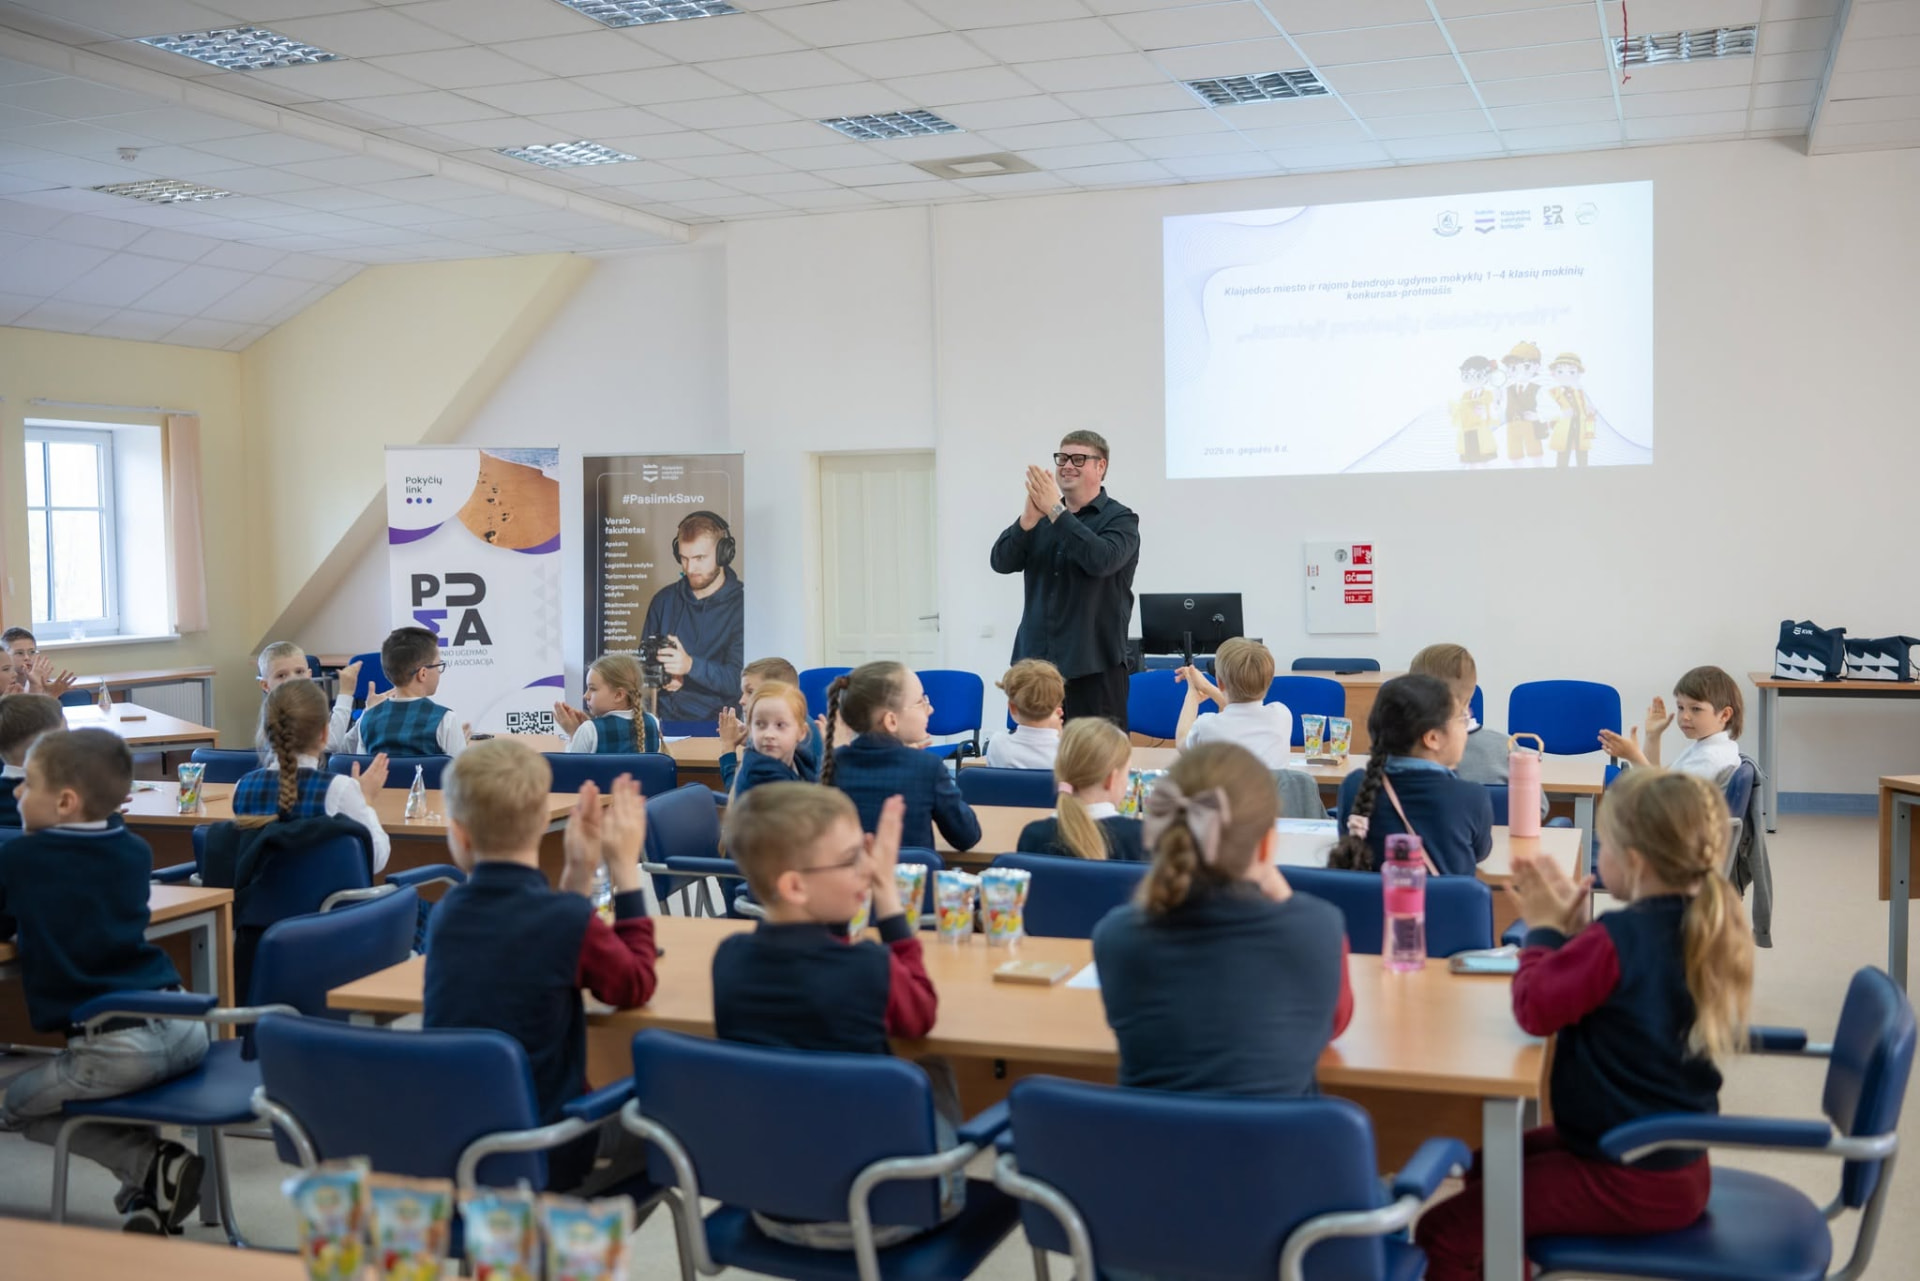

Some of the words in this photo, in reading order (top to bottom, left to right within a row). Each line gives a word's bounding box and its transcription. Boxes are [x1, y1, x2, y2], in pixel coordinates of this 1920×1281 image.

[1273, 282, 1306, 293] miesto
[1308, 281, 1315, 292] ir
[1318, 279, 1349, 292] rajono
[1351, 277, 1395, 289] bendrojo
[1397, 274, 1438, 287] ugdymo
[405, 476, 443, 485] Pokyčių
[405, 485, 423, 494] link
[622, 494, 705, 504] #PasiimkSavo
[604, 517, 631, 525] Verslo
[604, 526, 646, 535] fakultetas
